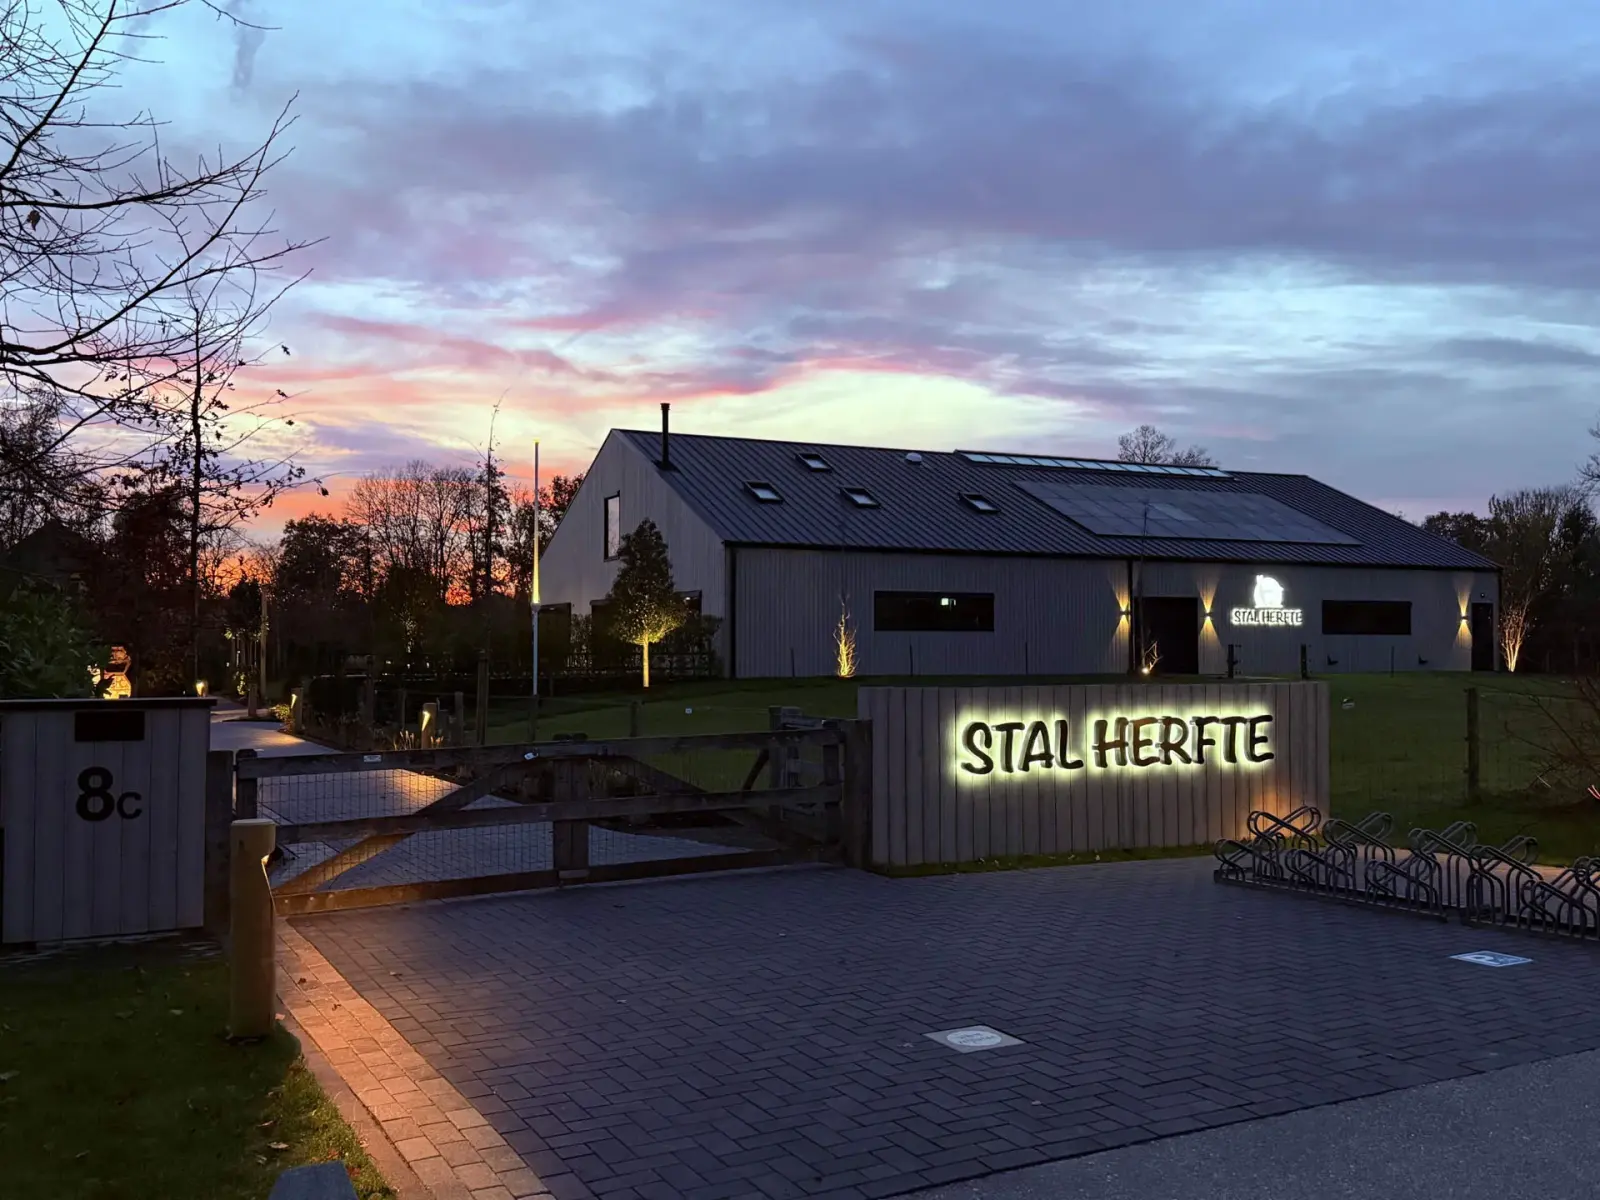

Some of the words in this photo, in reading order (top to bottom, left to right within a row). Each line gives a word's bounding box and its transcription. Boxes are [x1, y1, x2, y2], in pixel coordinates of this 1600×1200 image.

[1234, 610, 1260, 624] STAL
[1262, 609, 1303, 625] HERFTE
[961, 720, 1084, 775] STAL
[1092, 714, 1274, 768] HERFTE
